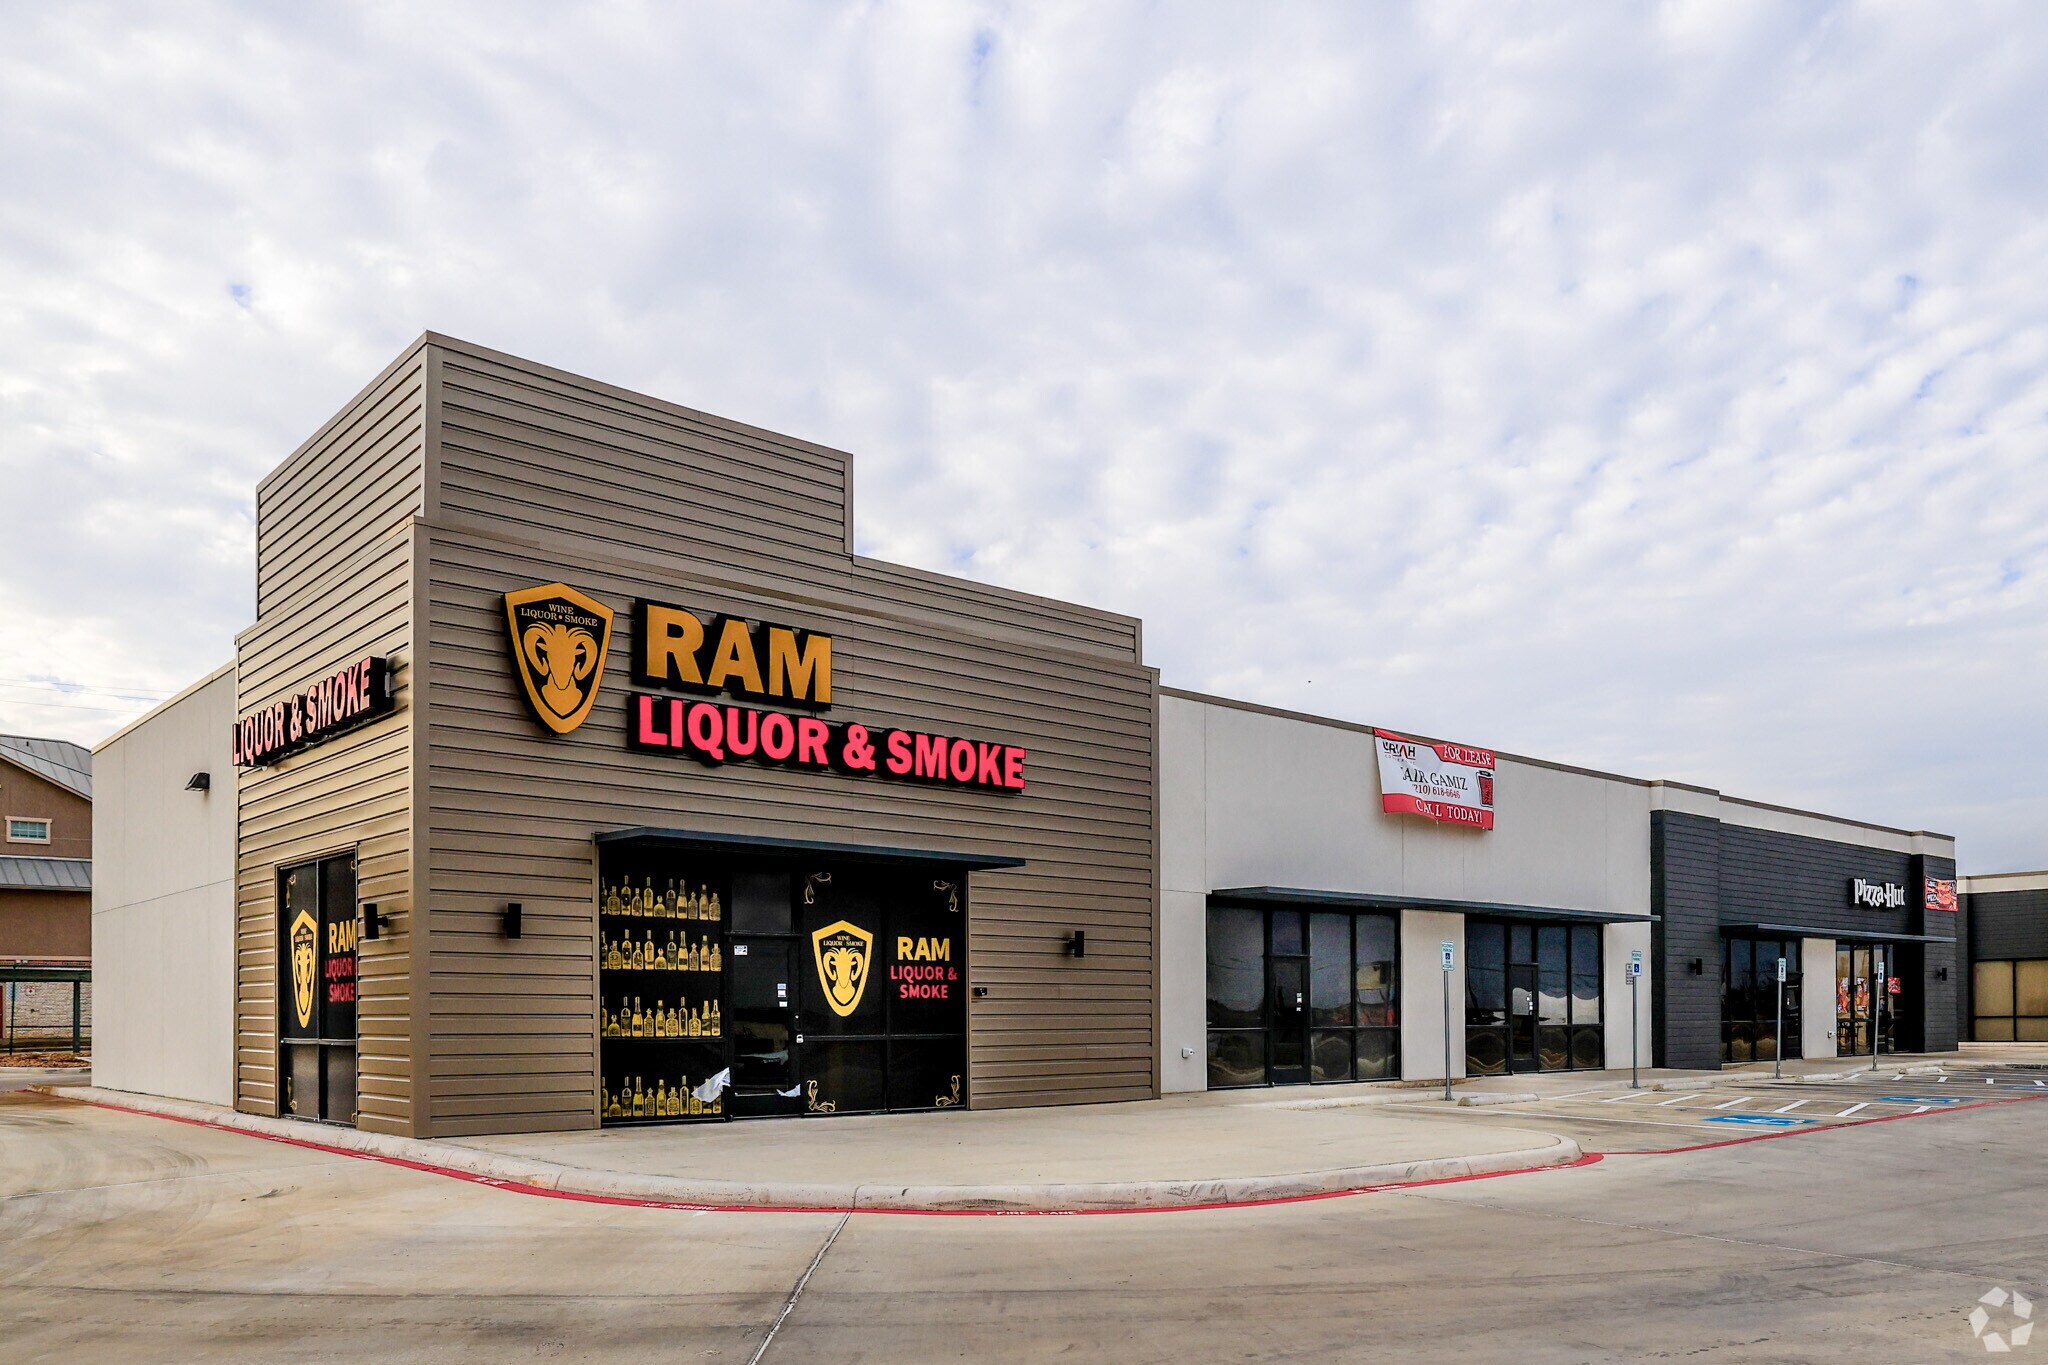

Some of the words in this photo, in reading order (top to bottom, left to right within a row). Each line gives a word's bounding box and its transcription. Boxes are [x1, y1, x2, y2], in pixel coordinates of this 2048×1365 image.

[521, 608, 557, 620] LIQUOR
[564, 615, 597, 626] SMOKE
[548, 604, 574, 614] WINE
[646, 604, 832, 704] RAM
[232, 701, 285, 766] LIQUOR
[289, 693, 302, 742] &
[305, 656, 371, 734] SMOKE
[639, 695, 830, 766] LIQUOR
[842, 723, 876, 771] &
[885, 730, 1026, 790] SMOKE
[1443, 744, 1461, 761] FOR
[1464, 749, 1492, 766] LEASE
[1430, 772, 1468, 791] GAMIZ
[1415, 799, 1442, 817] CALL
[1446, 805, 1483, 823] TODAY!
[1854, 878, 1885, 907] Pizza
[1885, 882, 1906, 908] Hut
[328, 919, 356, 954] RAM
[897, 936, 950, 962] RAM
[324, 957, 353, 982] LIQUOR
[890, 965, 944, 984] LIQUOR
[947, 967, 958, 981] &
[328, 982, 355, 1003] SMOKE
[899, 984, 949, 999] SMOKE
